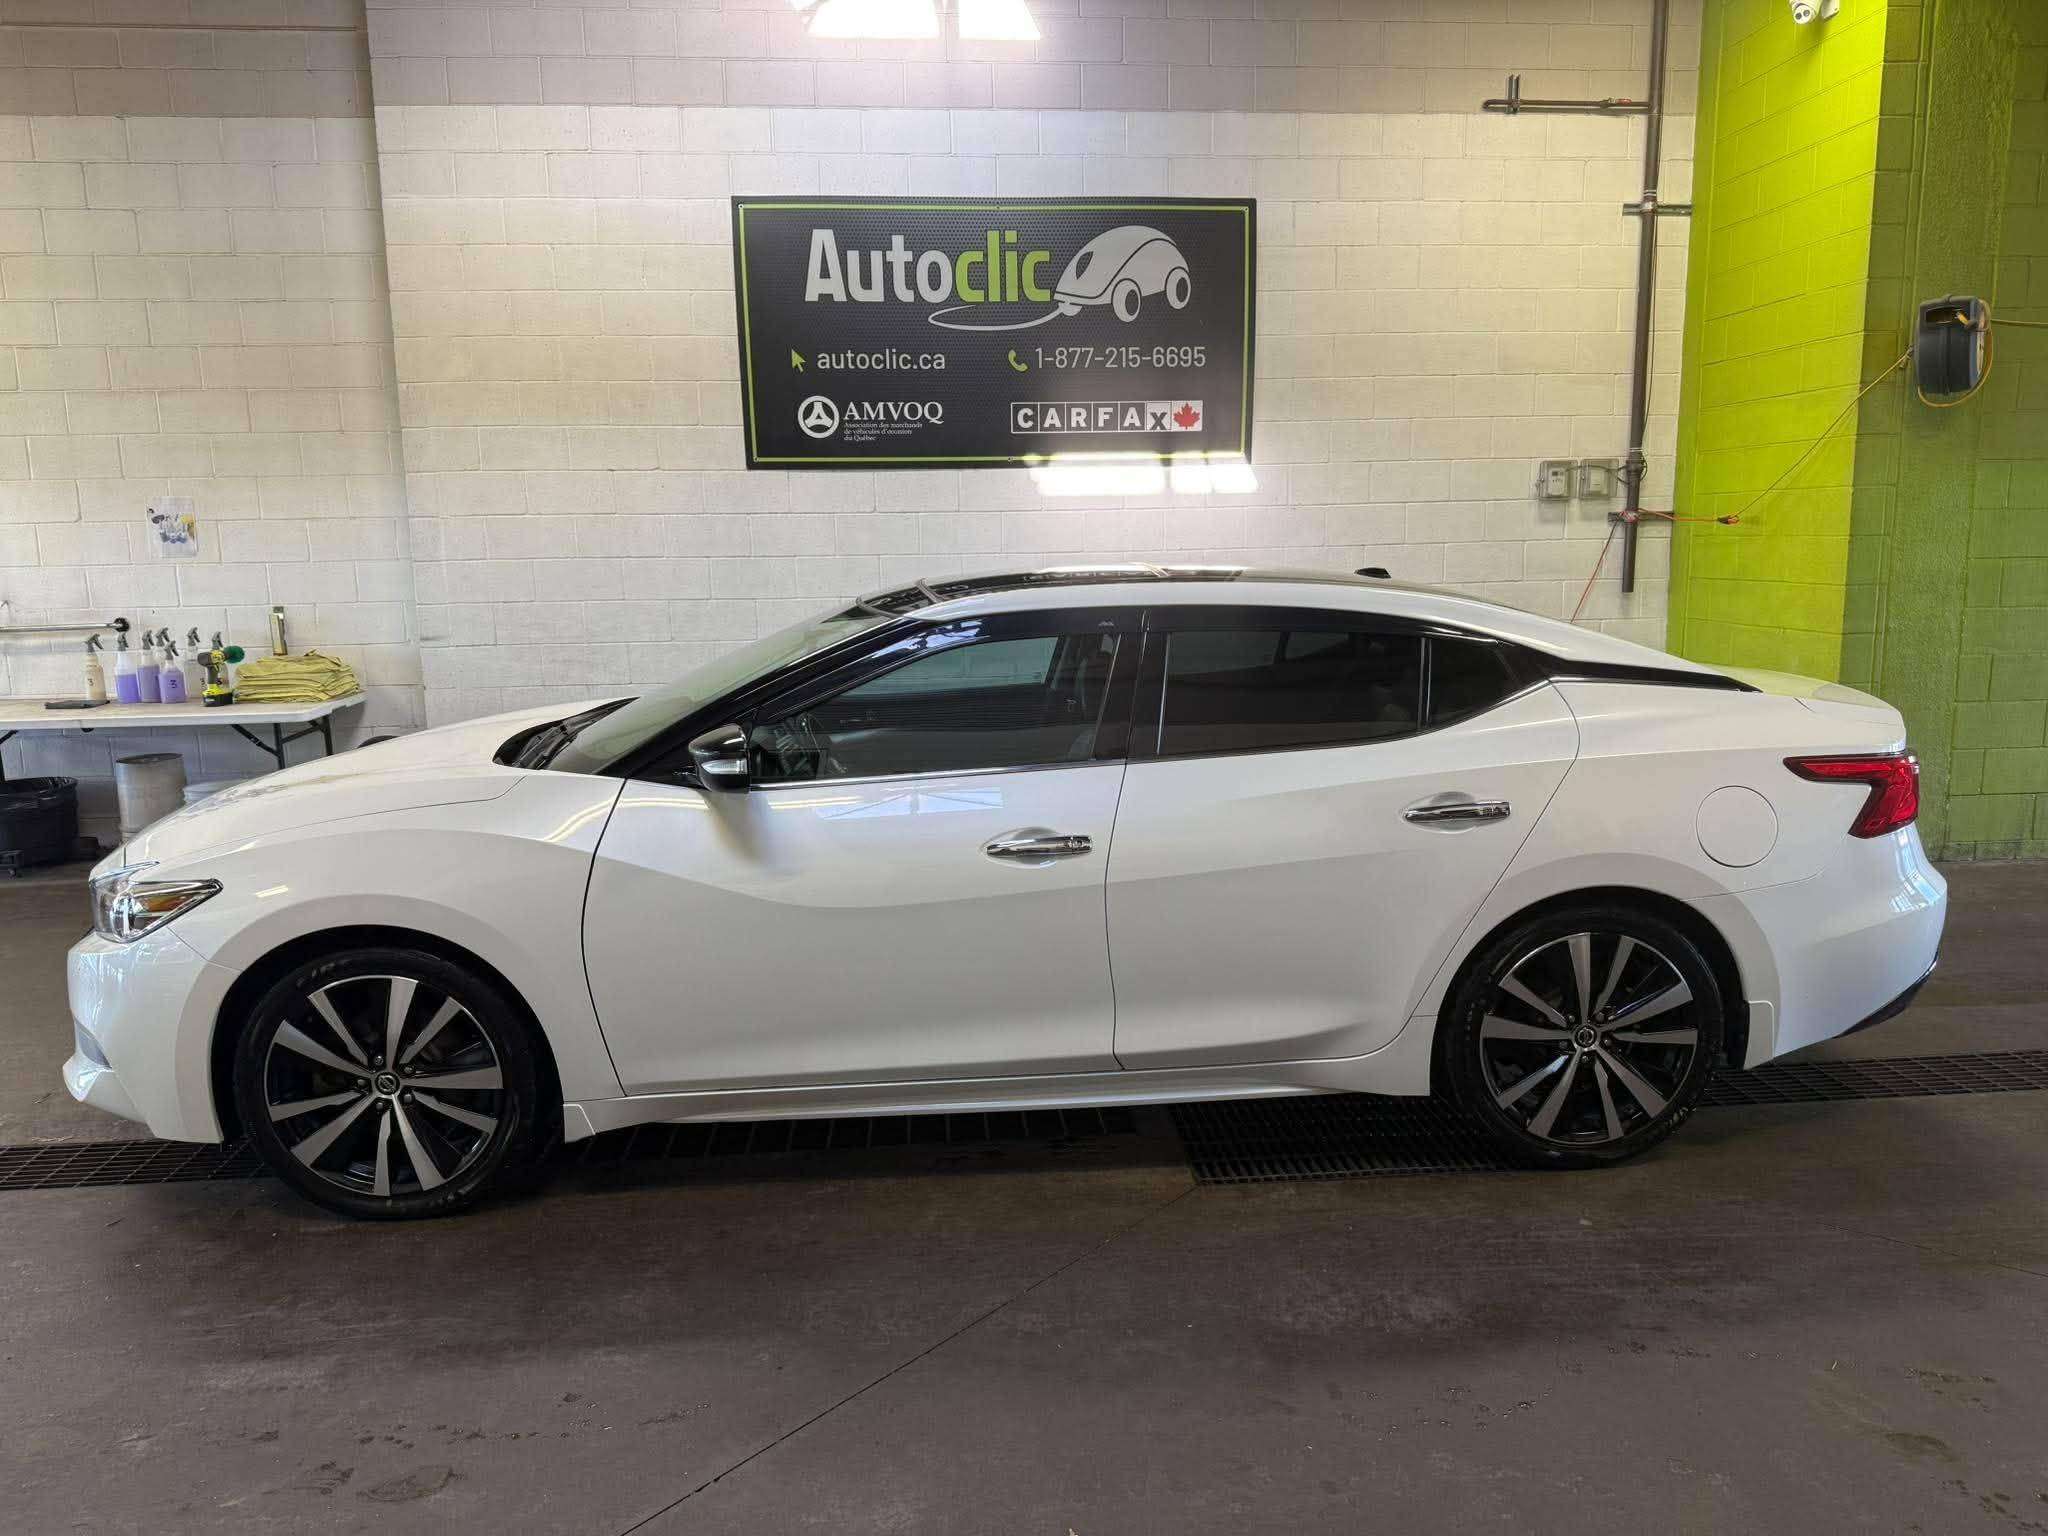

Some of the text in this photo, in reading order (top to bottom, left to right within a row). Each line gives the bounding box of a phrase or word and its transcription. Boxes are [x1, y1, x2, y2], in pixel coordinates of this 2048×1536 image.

[804, 228, 1051, 303] Autoclic
[816, 348, 946, 370] autoclic.ca
[1034, 346, 1207, 369] 1-877-215-6695
[843, 401, 945, 424] AMVOQ
[1016, 406, 1169, 431] CARFAX
